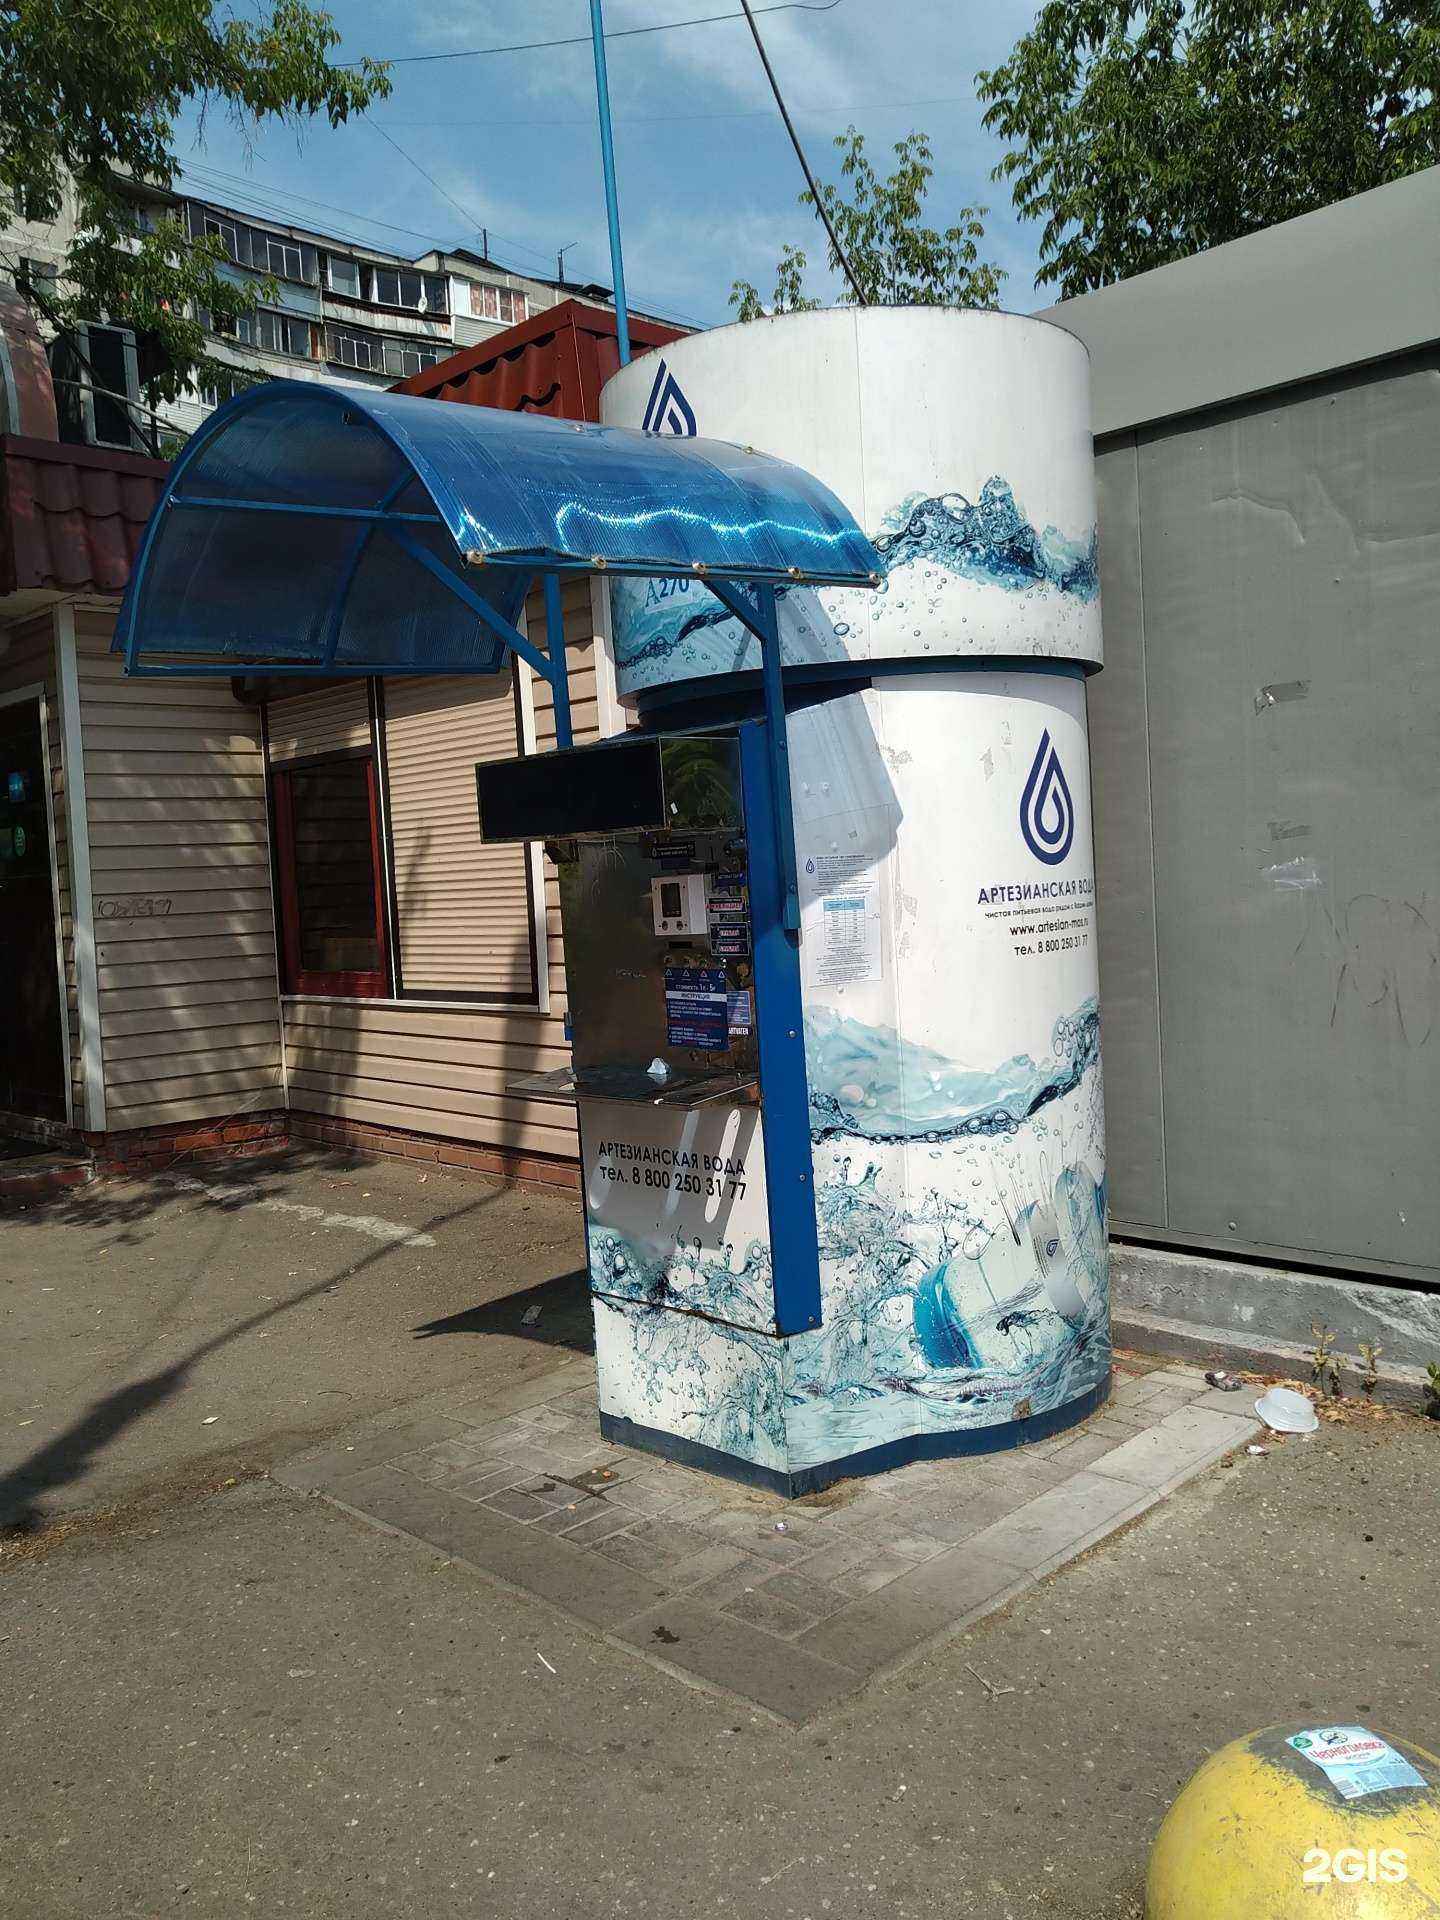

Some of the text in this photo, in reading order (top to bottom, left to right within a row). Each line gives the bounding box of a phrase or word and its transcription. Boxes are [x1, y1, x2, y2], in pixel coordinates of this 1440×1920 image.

[978, 880, 1077, 905] АРТЕЗИАНСКАЯ
[1014, 934, 1088, 956] тел. 8 800 250 31 77
[599, 1141, 746, 1176] АРТЕЗИАНСКАЯ ВОДА
[600, 1166, 747, 1201] тел. 8 800 250 31 77
